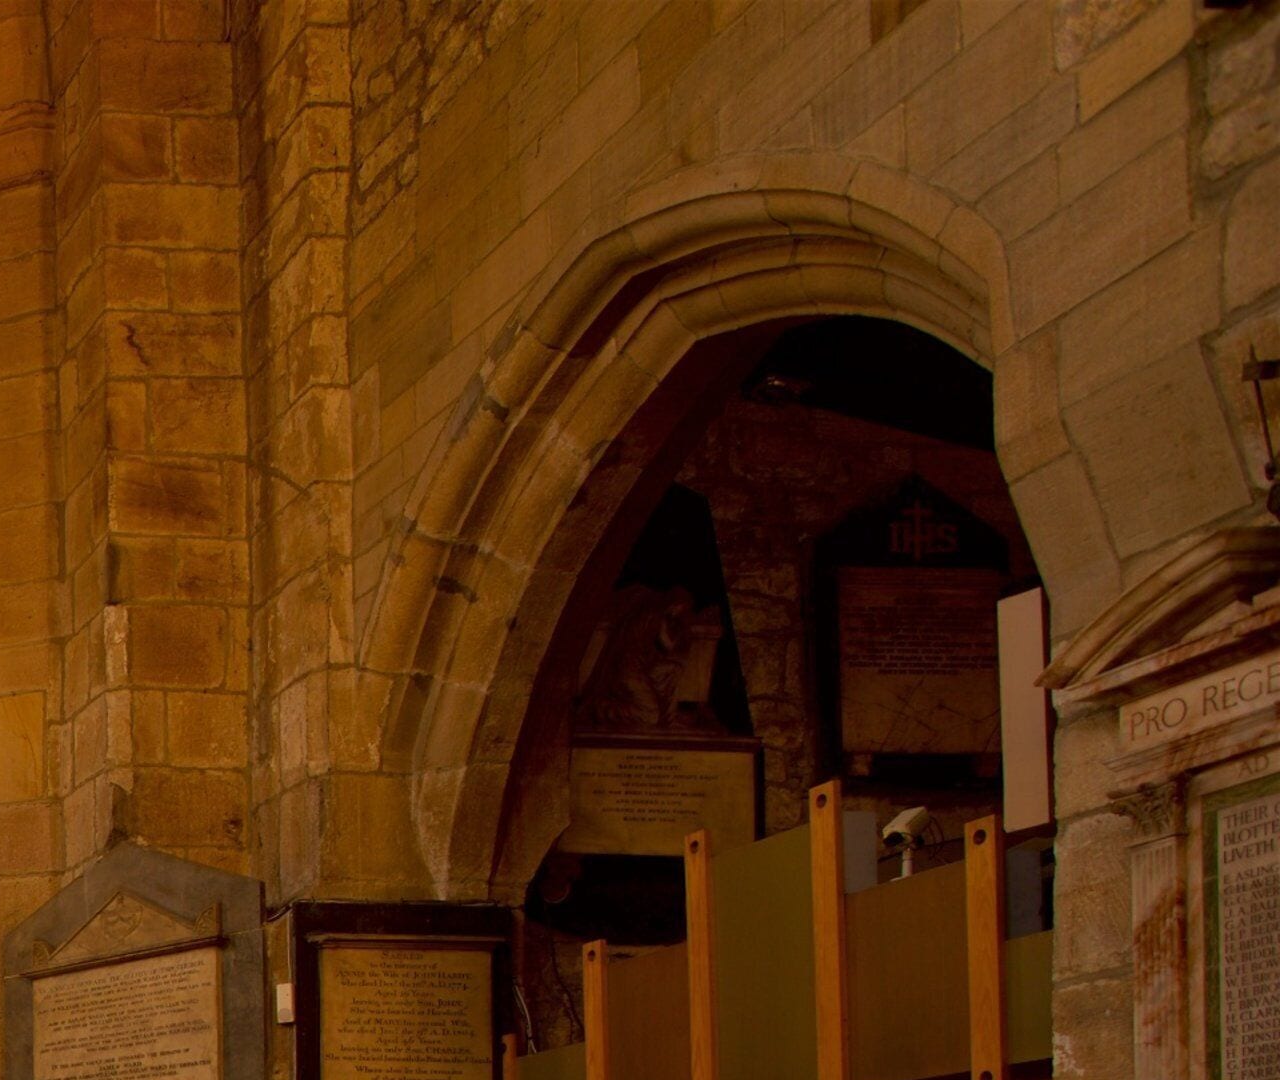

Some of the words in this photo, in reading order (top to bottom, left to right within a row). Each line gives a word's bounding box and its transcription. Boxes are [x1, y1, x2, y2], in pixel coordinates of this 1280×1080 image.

[1130, 697, 1187, 741] PRO
[1202, 661, 1280, 717] REGE
[1238, 753, 1270, 777] AD
[1224, 804, 1269, 828] THEIR
[1223, 839, 1274, 864] LIVETH
